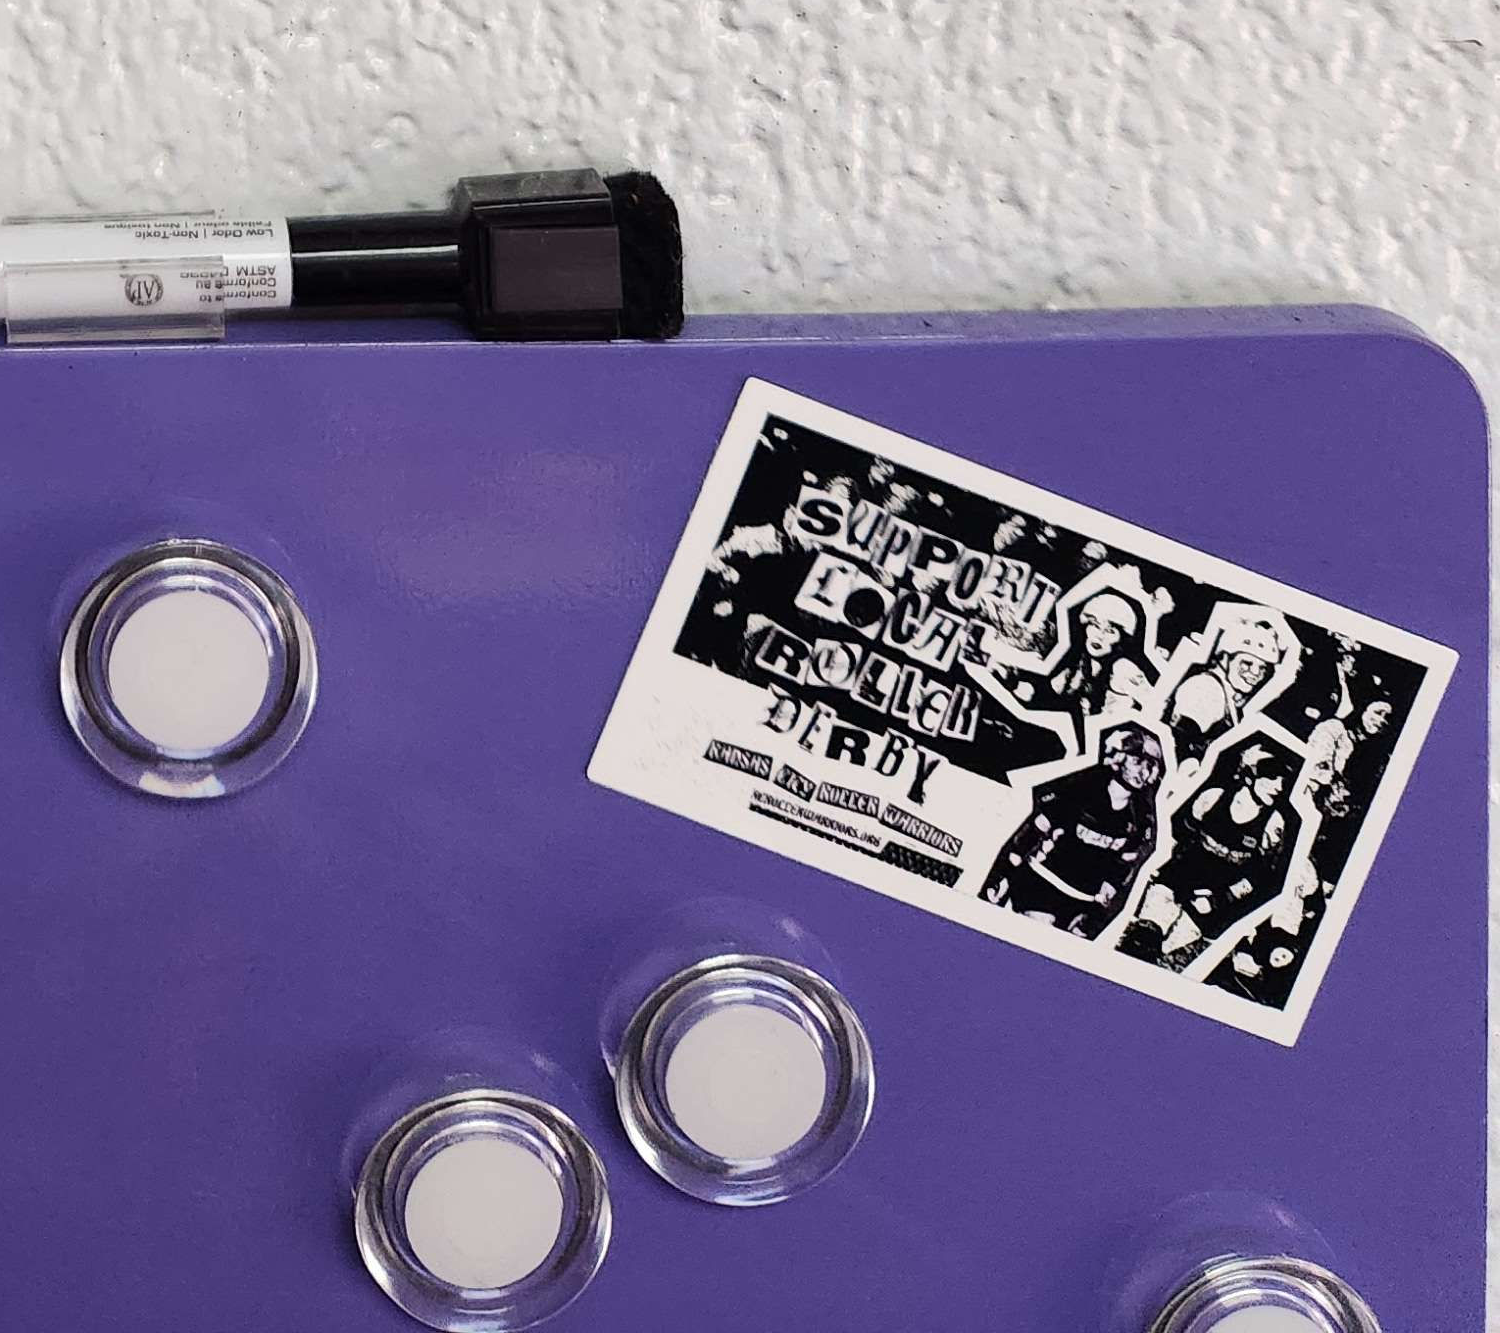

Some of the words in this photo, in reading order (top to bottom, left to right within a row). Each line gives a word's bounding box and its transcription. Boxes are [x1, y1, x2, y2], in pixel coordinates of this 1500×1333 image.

[135, 229, 199, 240] Non-Toxic
[211, 229, 243, 239] Odor
[246, 229, 274, 238] Low
[199, 293, 212, 303] to
[236, 265, 277, 277] ASTM
[798, 488, 1060, 627] SUPPORT
[799, 555, 991, 669] LOCAL
[759, 626, 981, 740] ROLLER
[761, 685, 944, 806] DERBY
[704, 740, 773, 781] KANSAS
[817, 782, 879, 817] ROLLER
[880, 804, 963, 857] WARRIORS
